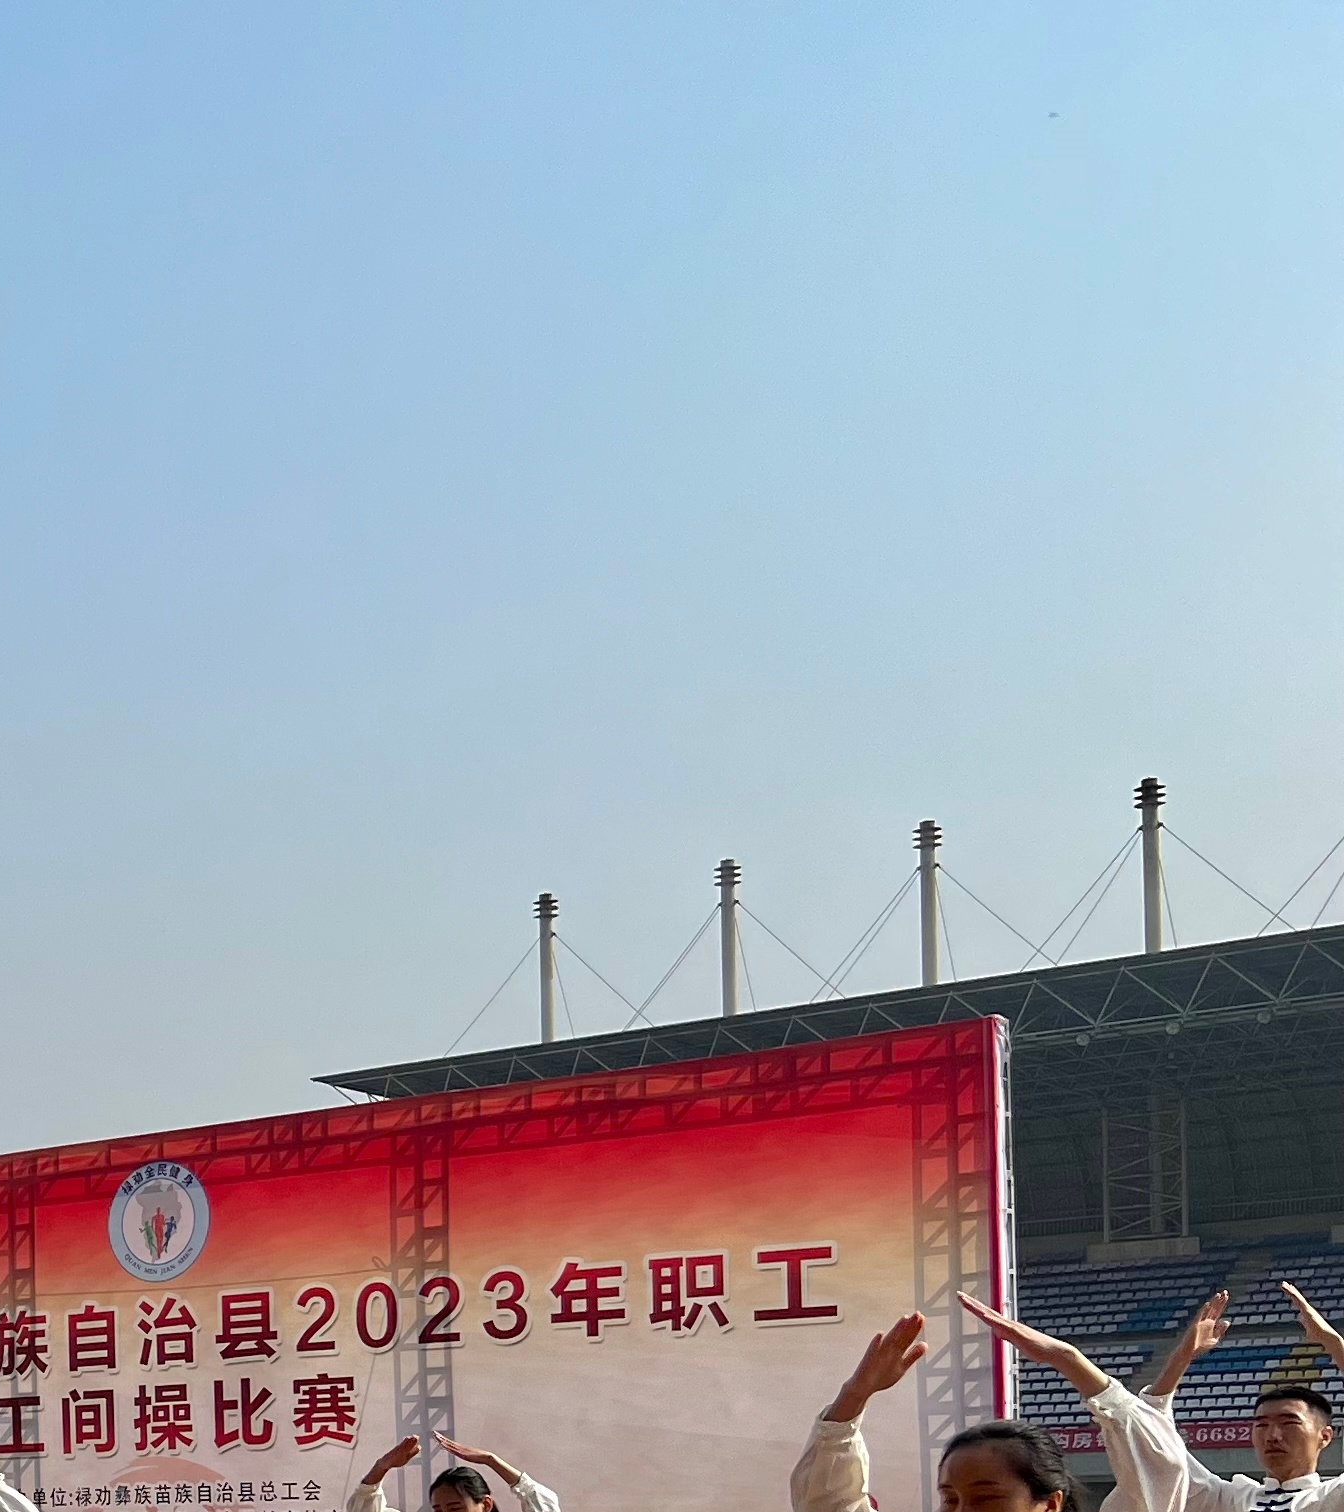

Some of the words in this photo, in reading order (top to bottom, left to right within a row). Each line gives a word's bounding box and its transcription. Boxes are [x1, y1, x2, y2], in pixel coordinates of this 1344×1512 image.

[121, 1163, 194, 1196] 禄劝全民健身
[18, 1480, 322, 1508] 单位:禄劝彝族苗族自治县总工会
